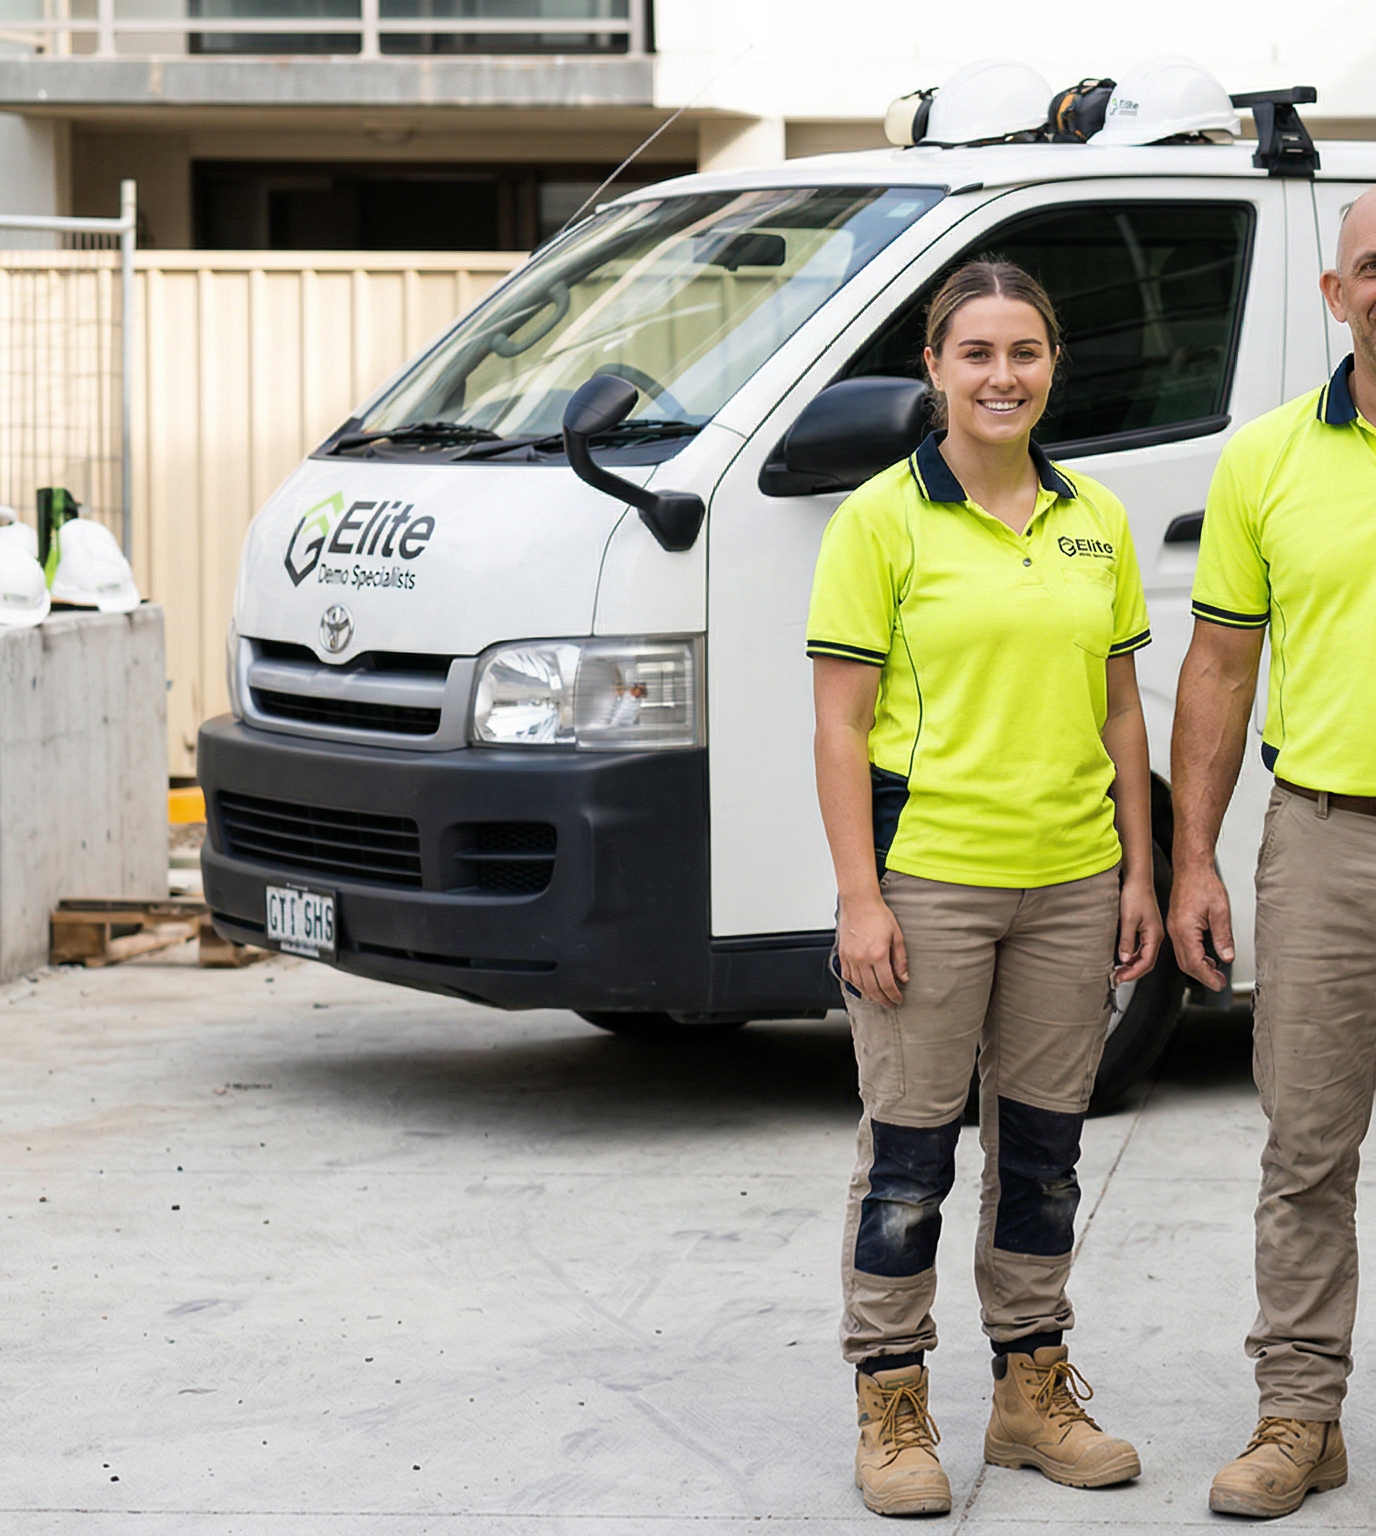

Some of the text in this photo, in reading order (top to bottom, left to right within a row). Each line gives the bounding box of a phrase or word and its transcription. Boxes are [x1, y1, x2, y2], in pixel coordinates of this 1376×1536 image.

[327, 501, 436, 560] Elite
[1075, 539, 1113, 554] Elite
[318, 563, 349, 585] Demo
